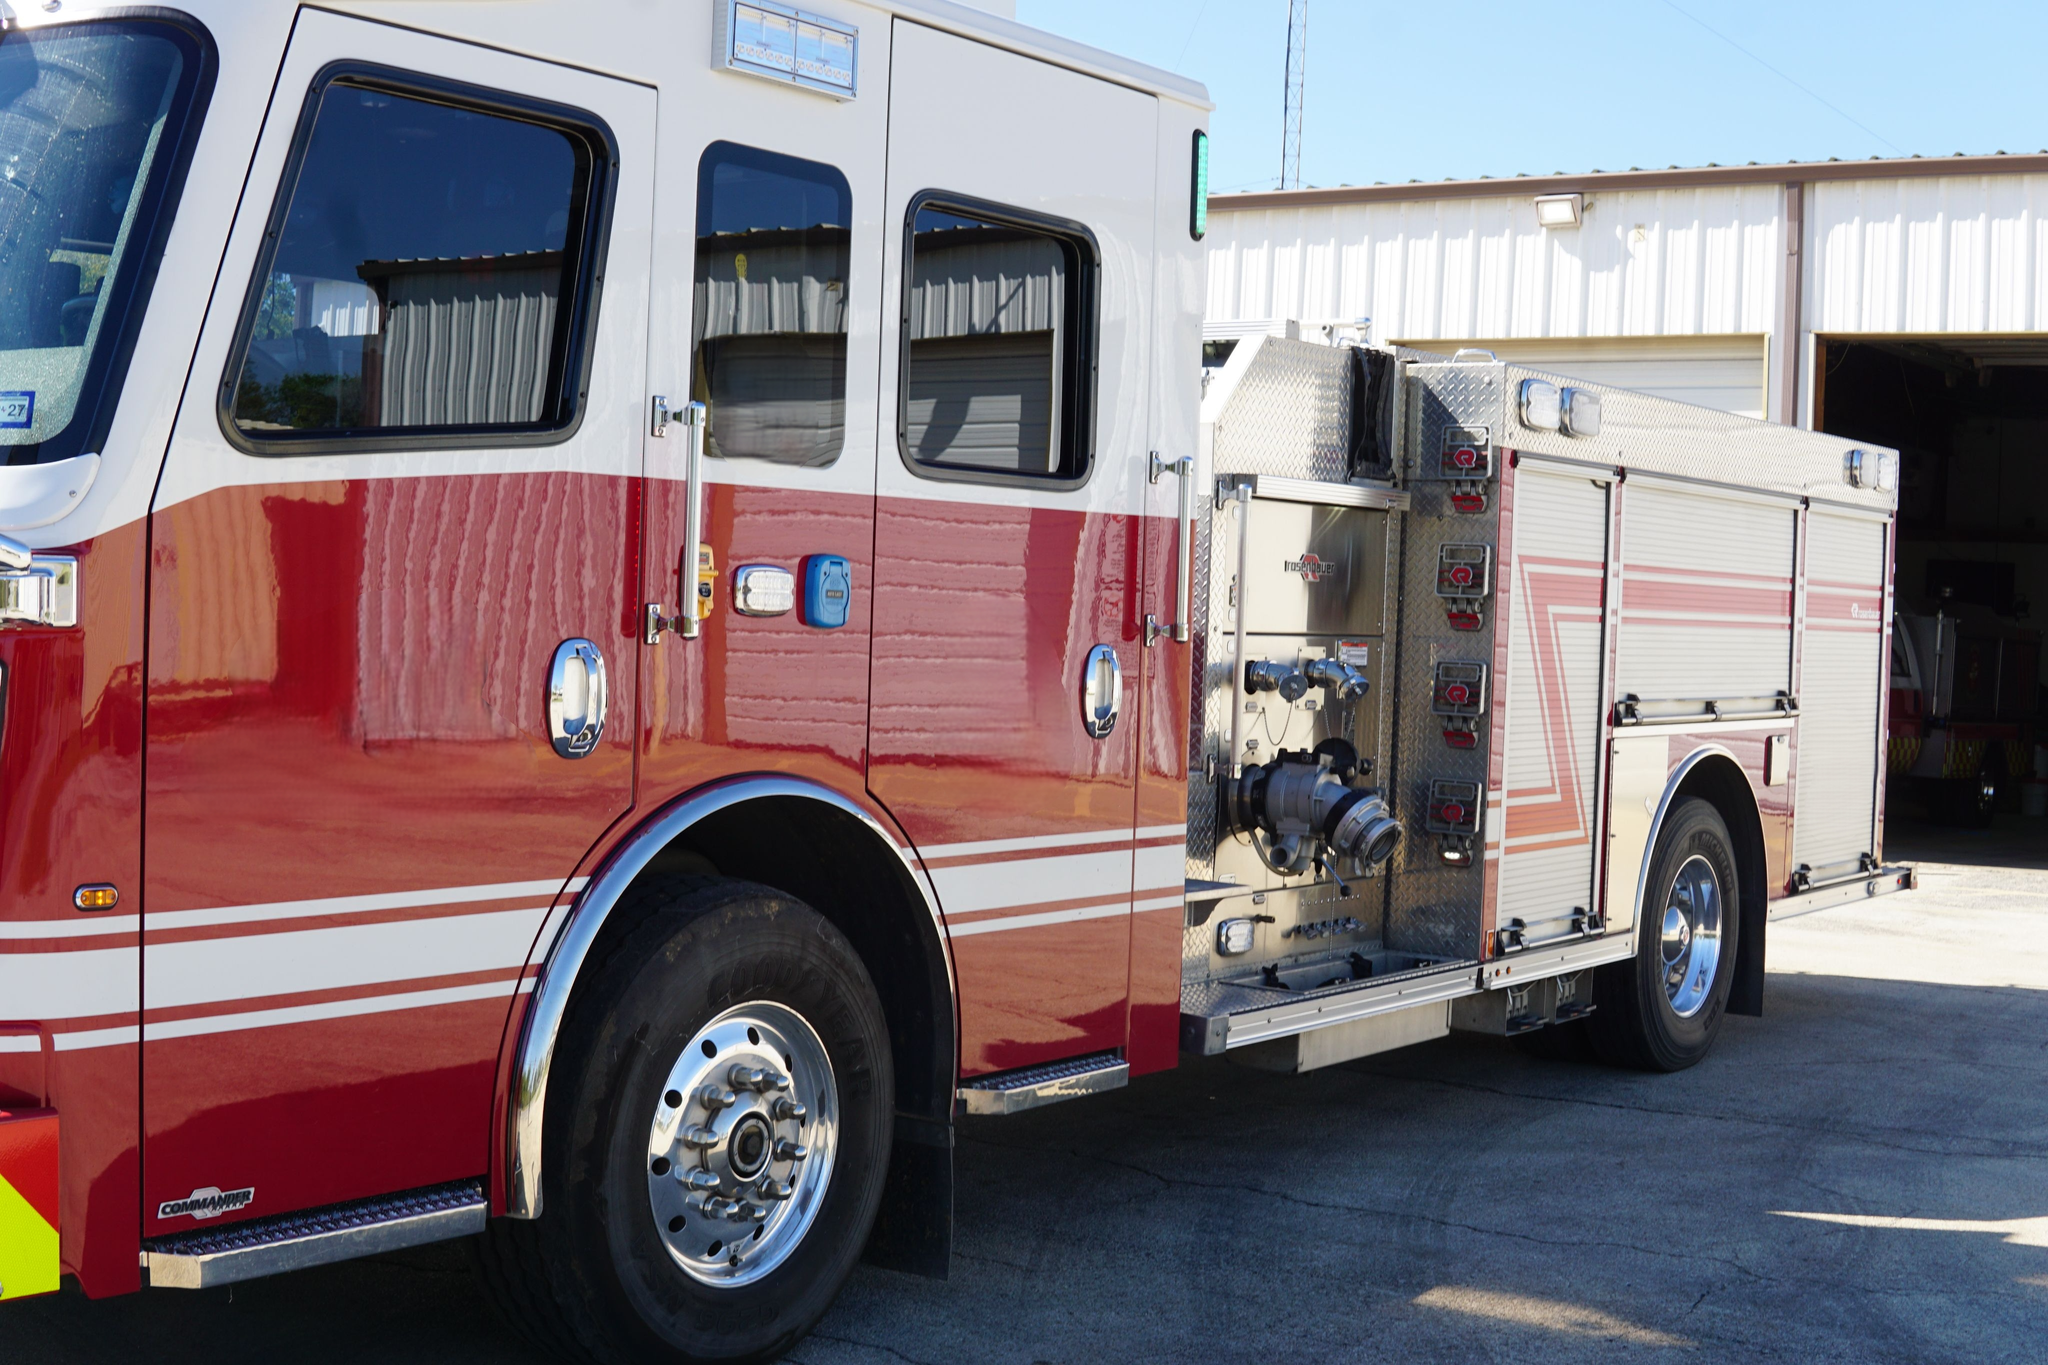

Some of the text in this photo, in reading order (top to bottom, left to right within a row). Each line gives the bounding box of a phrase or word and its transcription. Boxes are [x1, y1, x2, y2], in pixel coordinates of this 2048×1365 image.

[7, 404, 26, 417] 27
[1286, 558, 1336, 575] rosenbauer
[1699, 831, 1734, 891] MICHELIN
[707, 954, 872, 1103] GOODYEAR
[161, 1190, 252, 1216] COMMANDER
